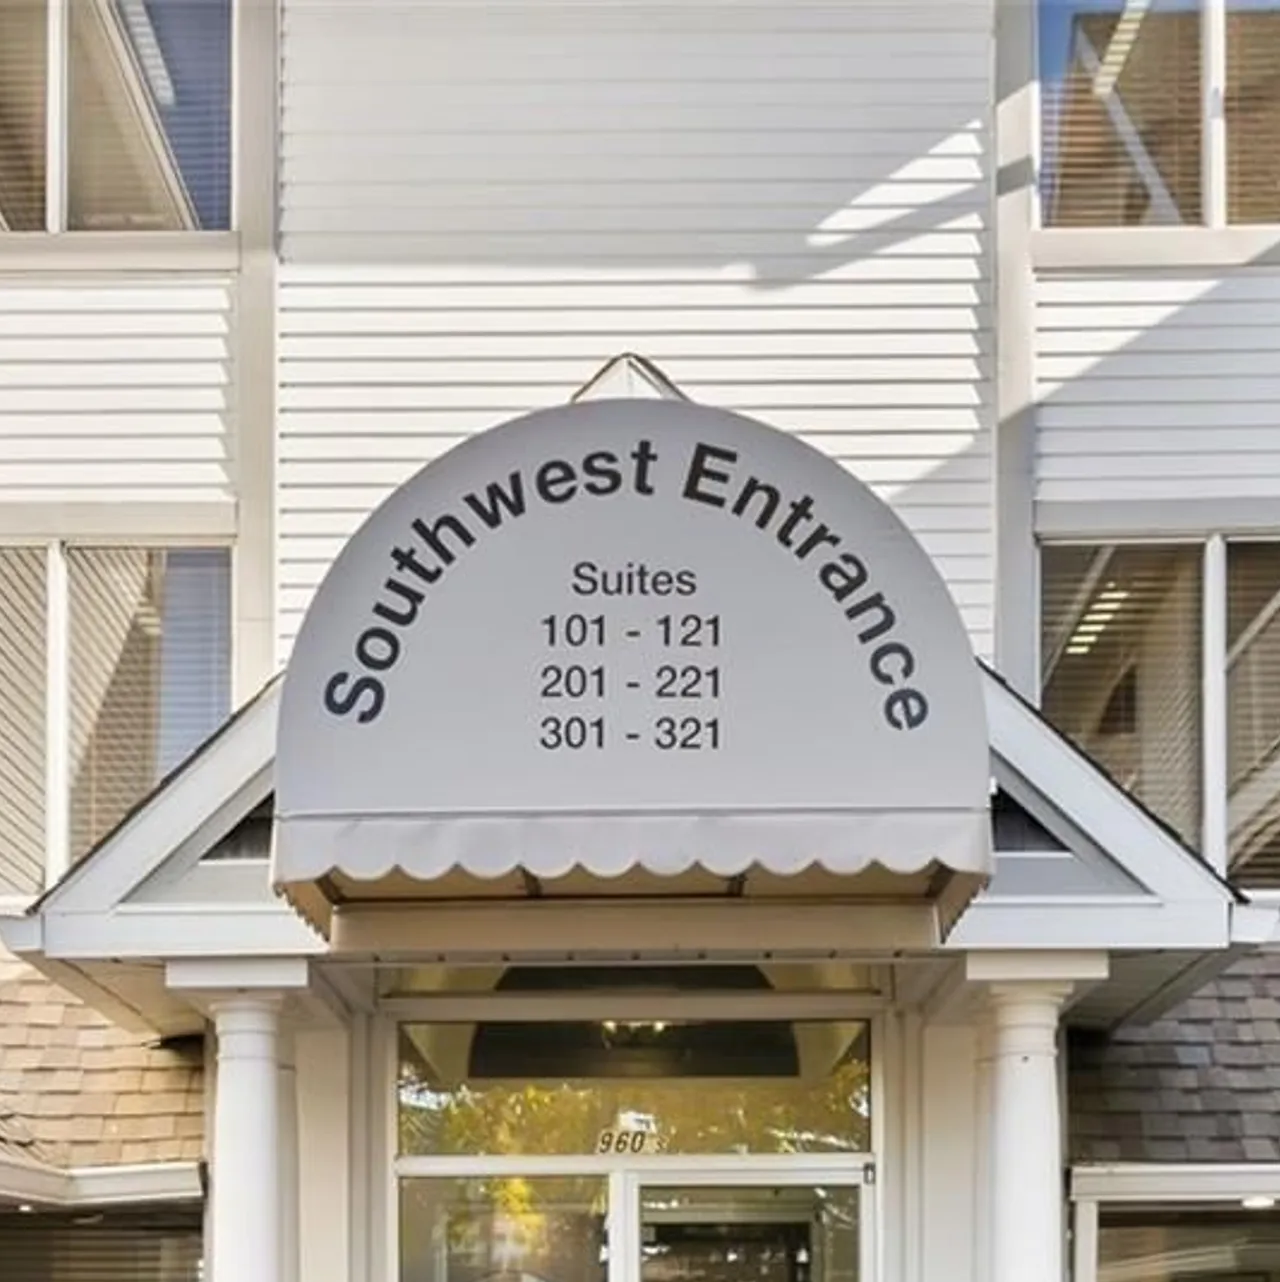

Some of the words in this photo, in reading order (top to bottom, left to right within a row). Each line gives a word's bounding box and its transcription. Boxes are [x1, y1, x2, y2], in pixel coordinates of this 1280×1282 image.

[323, 440, 658, 725] Southwest
[681, 442, 930, 732] Entrance
[571, 561, 697, 597] Suites
[541, 613, 607, 648] 101
[656, 613, 721, 648] 121
[540, 664, 606, 699] 201
[655, 664, 720, 699] 221
[539, 716, 606, 751] 301
[654, 716, 720, 751] 321
[599, 1131, 646, 1153] 960
